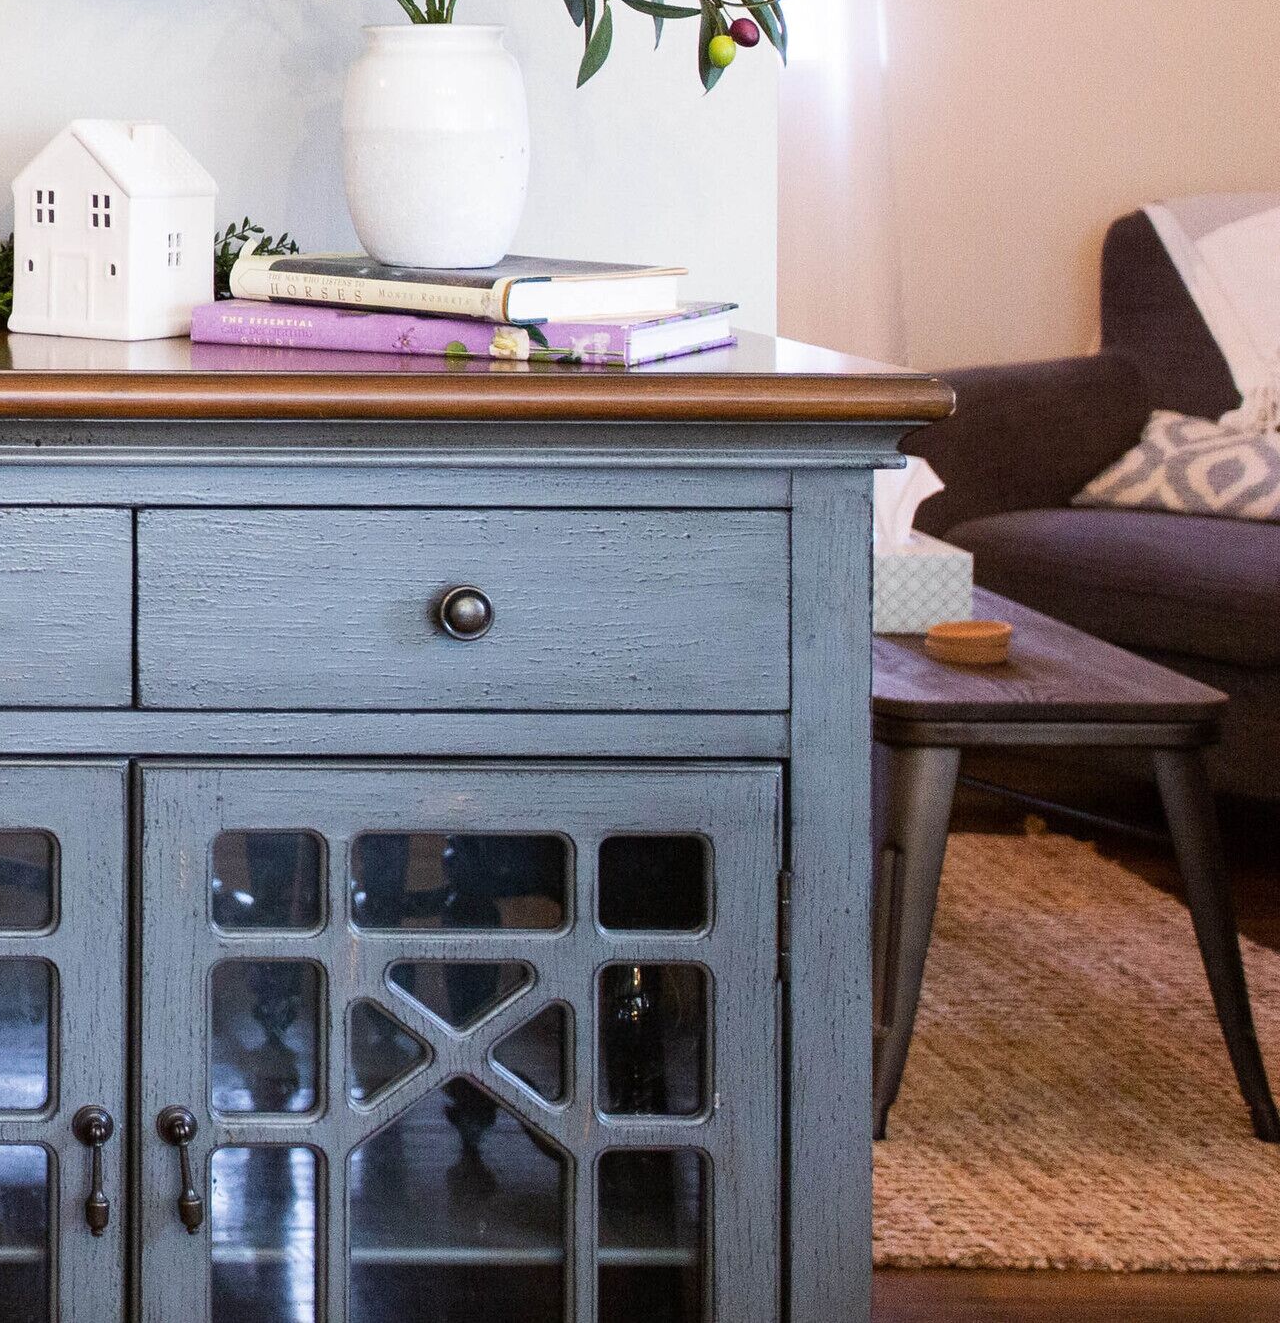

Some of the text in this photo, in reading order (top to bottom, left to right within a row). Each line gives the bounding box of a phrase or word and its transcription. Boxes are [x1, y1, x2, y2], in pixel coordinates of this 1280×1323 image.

[303, 276, 319, 284] WHO
[322, 278, 352, 287] LISTENS
[270, 283, 363, 302] HORSES
[221, 316, 313, 328] THE ESSENTIAL
[241, 336, 295, 346] GUIDE
